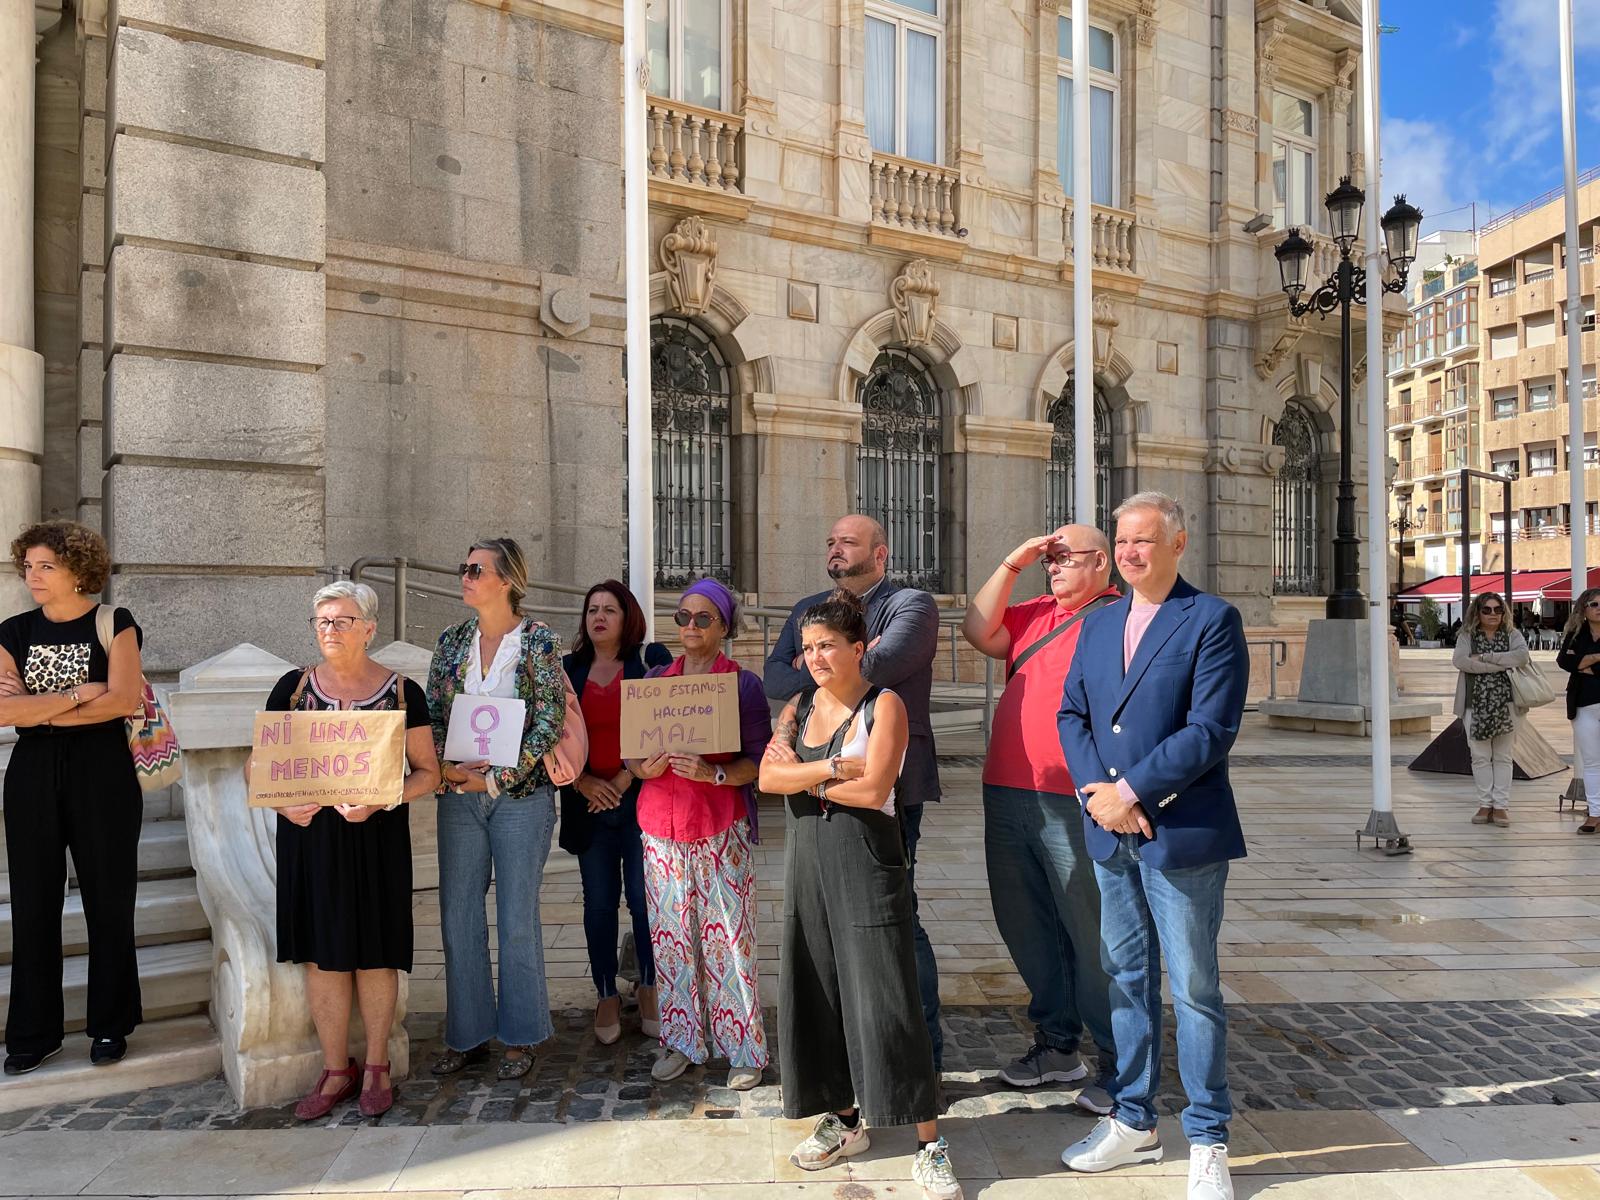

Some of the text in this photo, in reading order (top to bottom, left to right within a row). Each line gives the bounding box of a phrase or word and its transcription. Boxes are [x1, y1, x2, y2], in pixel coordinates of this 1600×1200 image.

[626, 682, 727, 700] ALGO ESTAMOS
[653, 705, 713, 721] HACIENDO
[309, 720, 368, 743] UNA
[640, 722, 708, 750] MAL
[270, 750, 372, 782] MENOS
